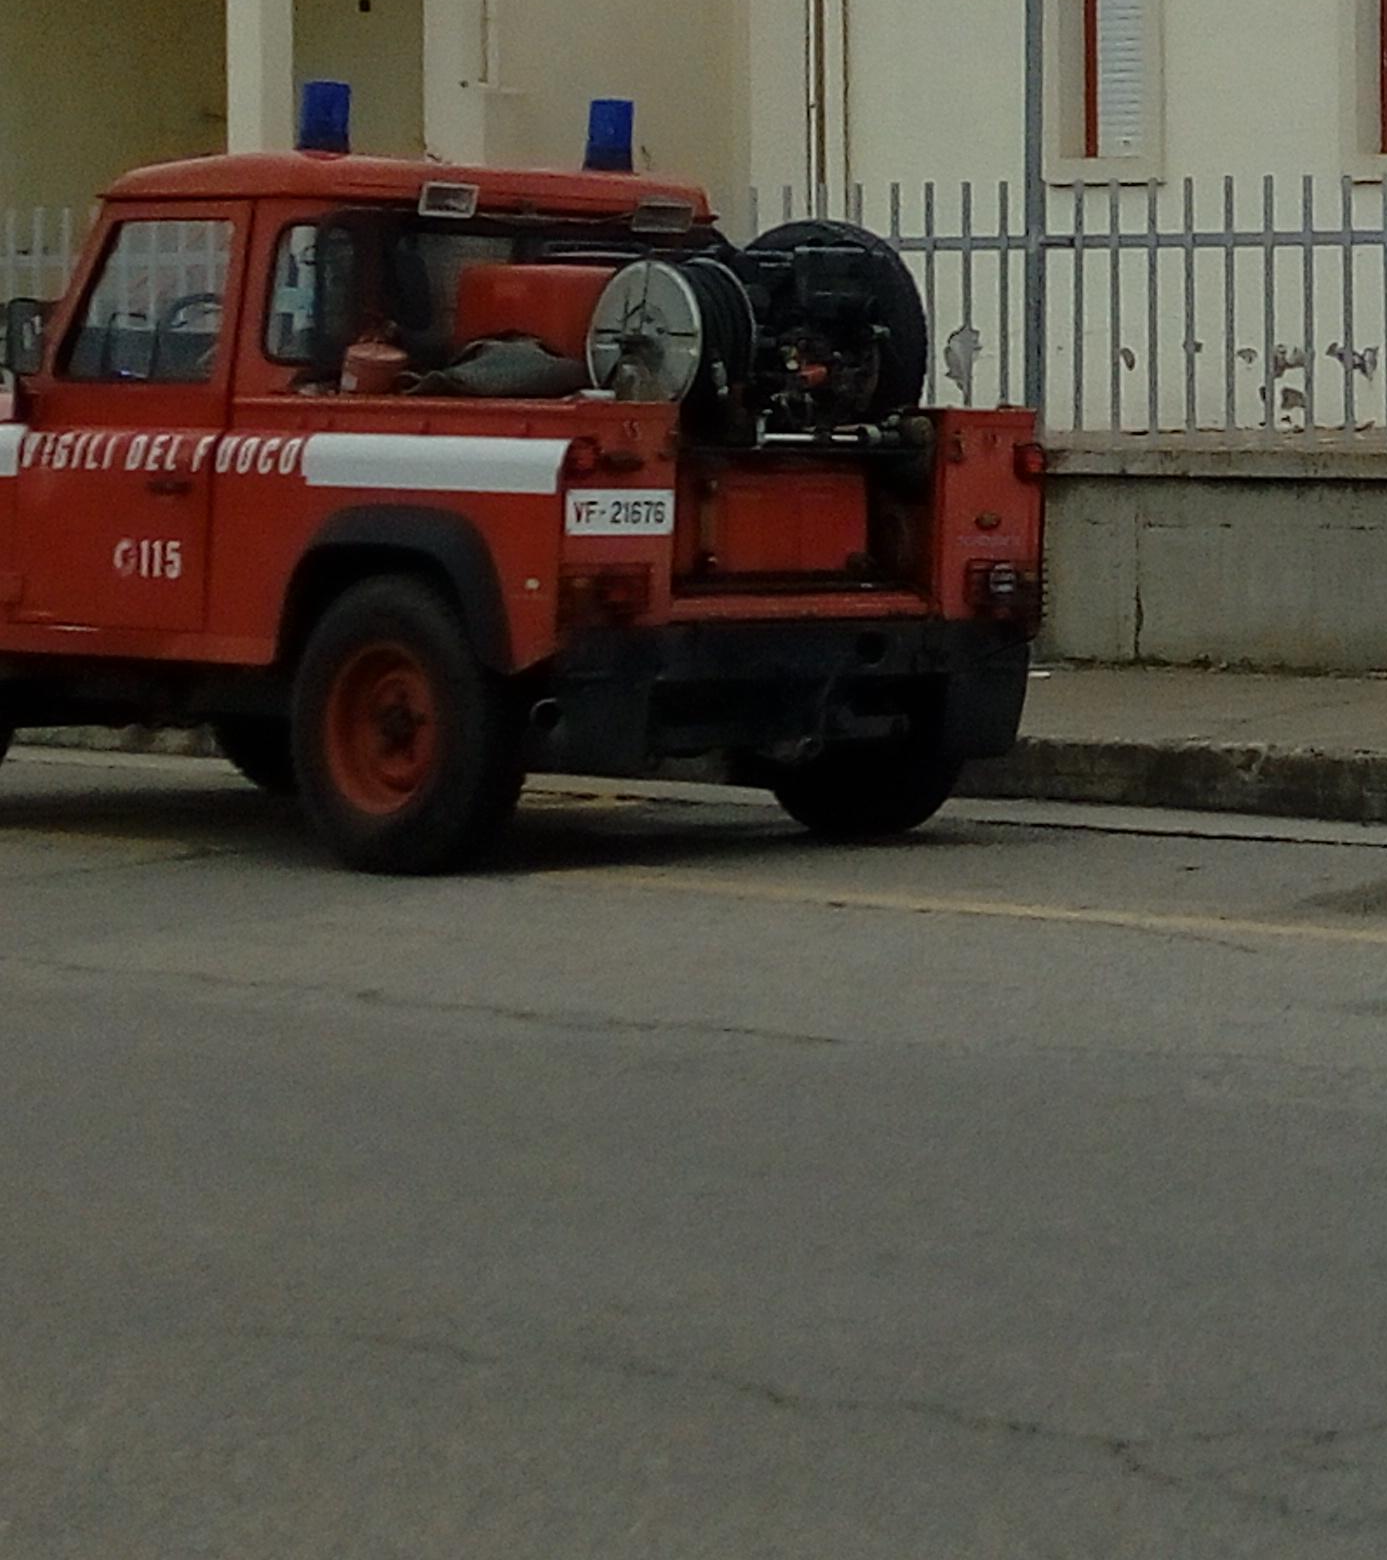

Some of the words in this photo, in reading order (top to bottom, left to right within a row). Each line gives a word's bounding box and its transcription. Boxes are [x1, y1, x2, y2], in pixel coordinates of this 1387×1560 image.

[22, 431, 122, 470] VIGILI
[124, 434, 184, 471] DEL
[191, 435, 302, 475] FUOCO
[140, 540, 181, 579] 115
